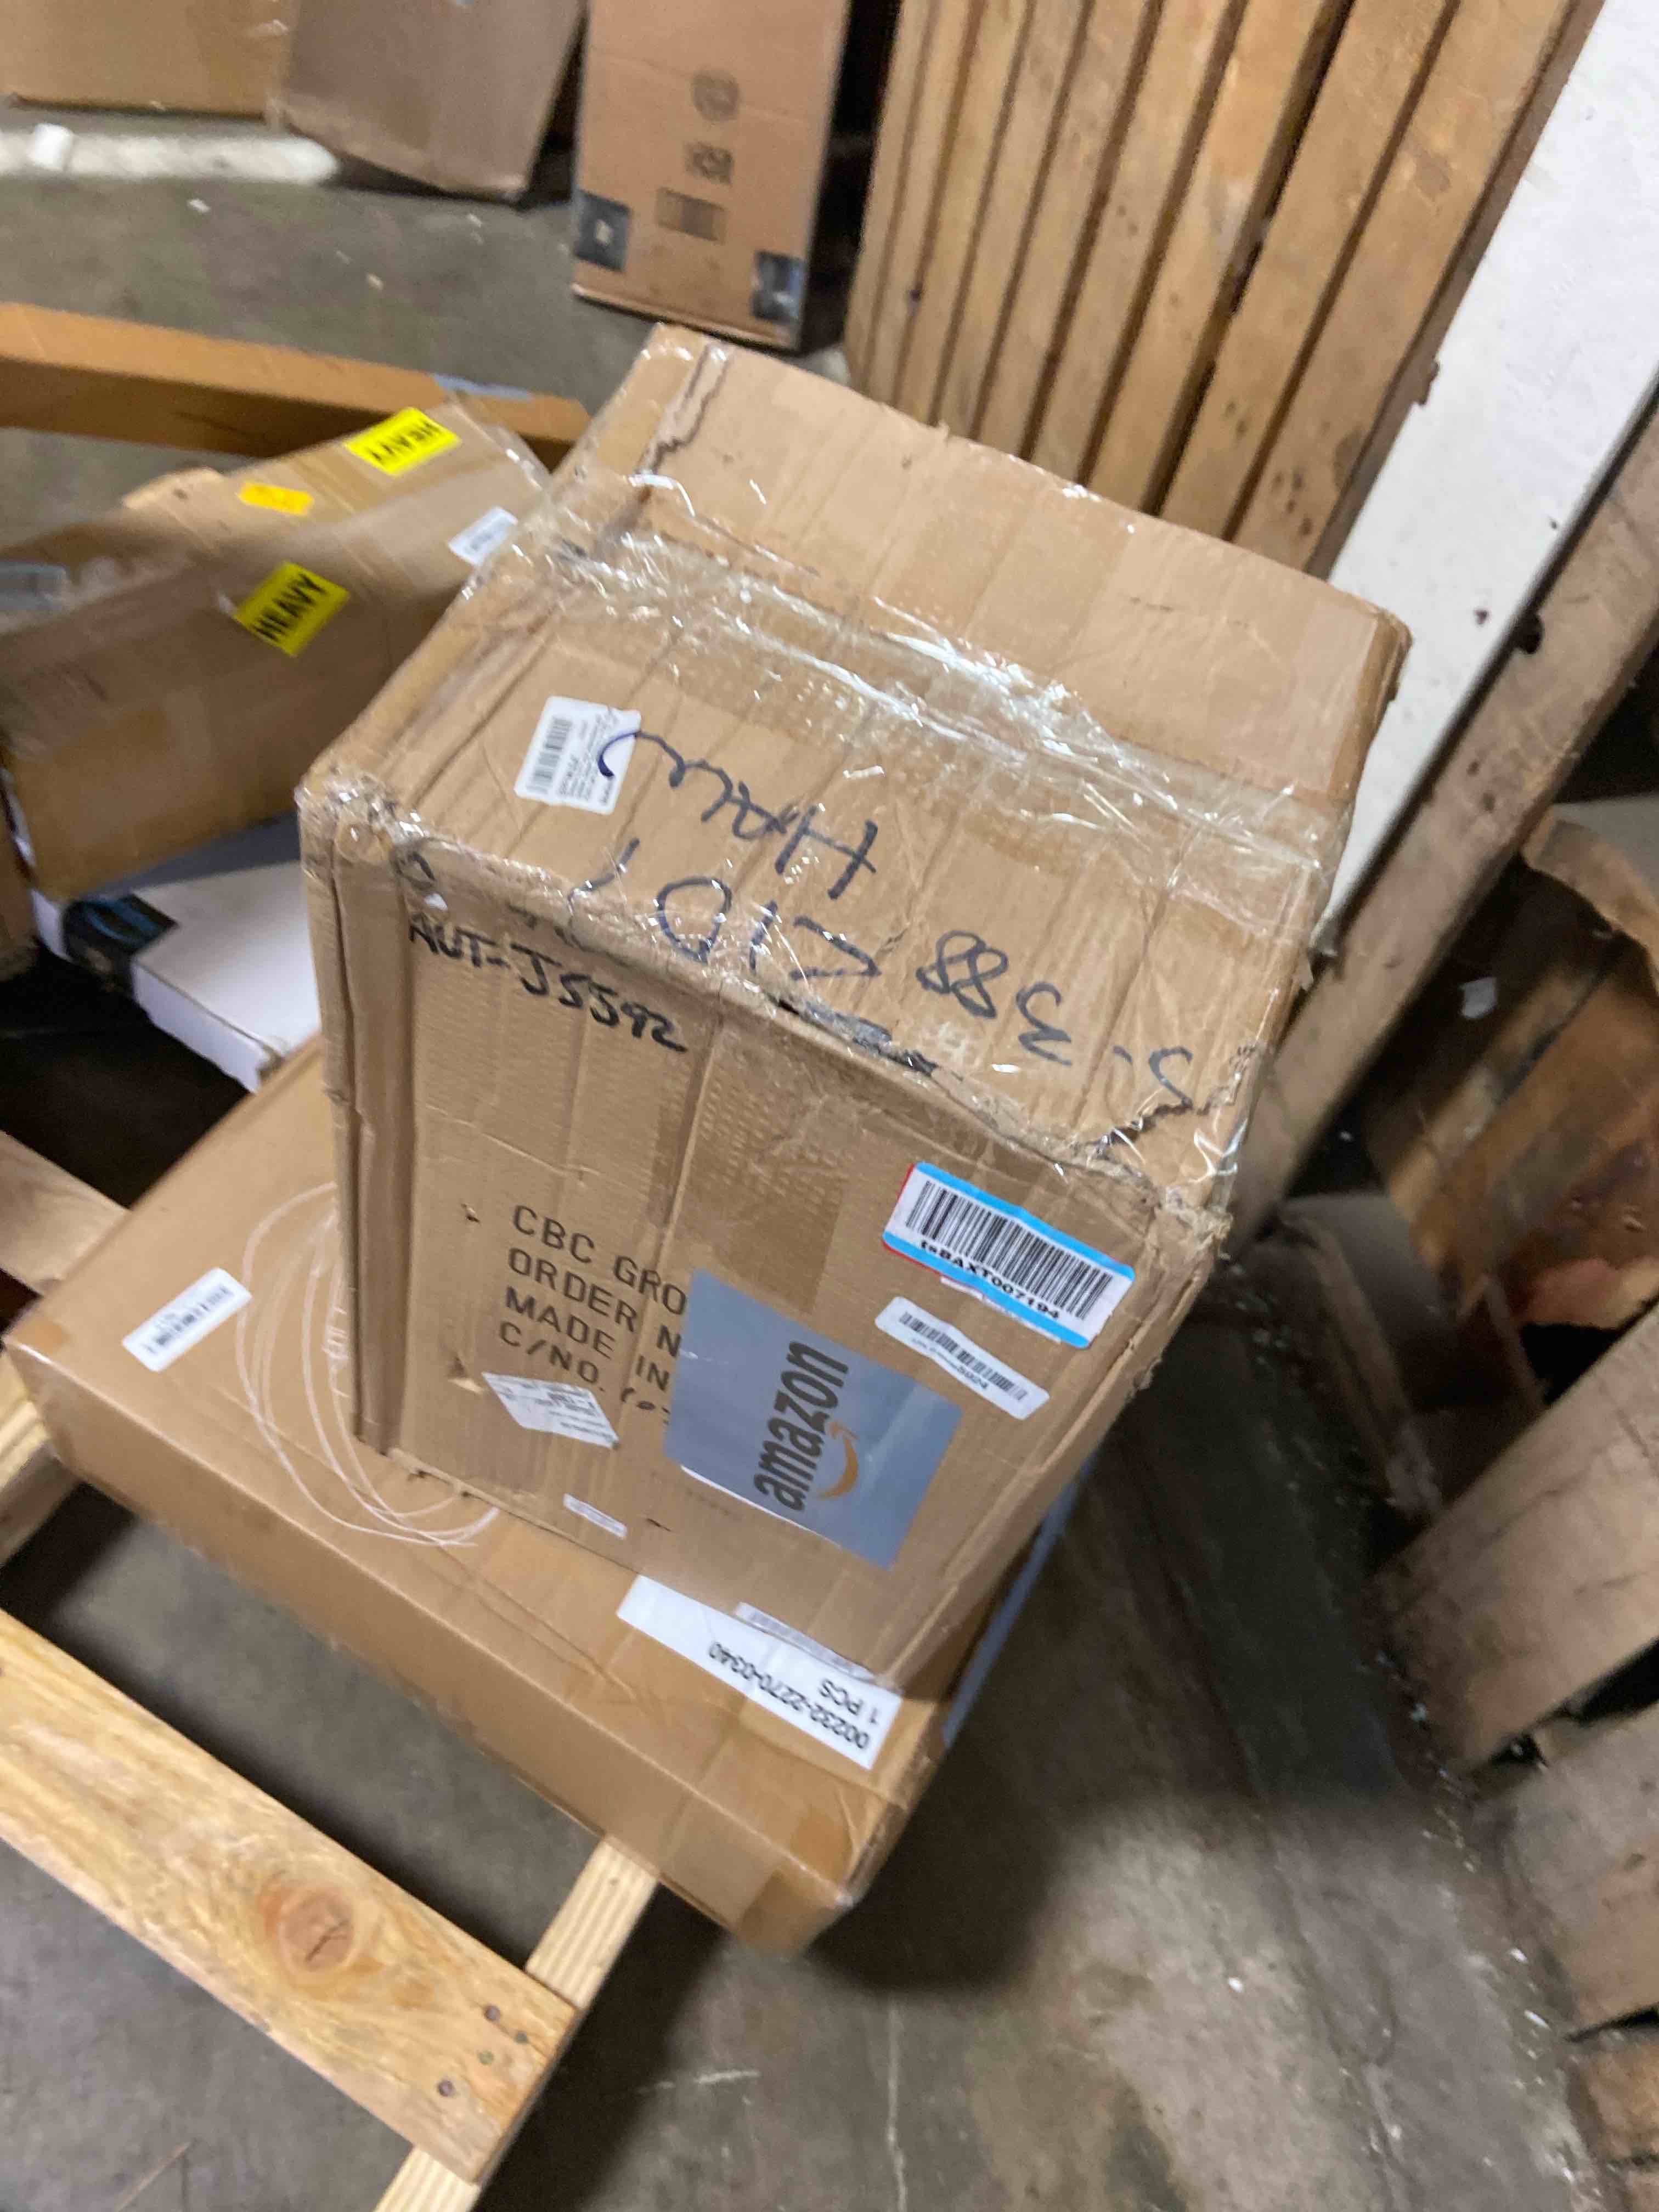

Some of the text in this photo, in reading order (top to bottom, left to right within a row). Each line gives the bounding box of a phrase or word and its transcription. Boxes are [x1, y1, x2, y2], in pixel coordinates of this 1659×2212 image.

[252, 572, 327, 643] HEAVY
[512, 1204, 595, 1264] CBC
[507, 1246, 639, 1334] ORDER
[505, 1285, 670, 1392] MADE IN
[753, 1340, 849, 1512] amazon
[820, 1679, 863, 1716] PCS
